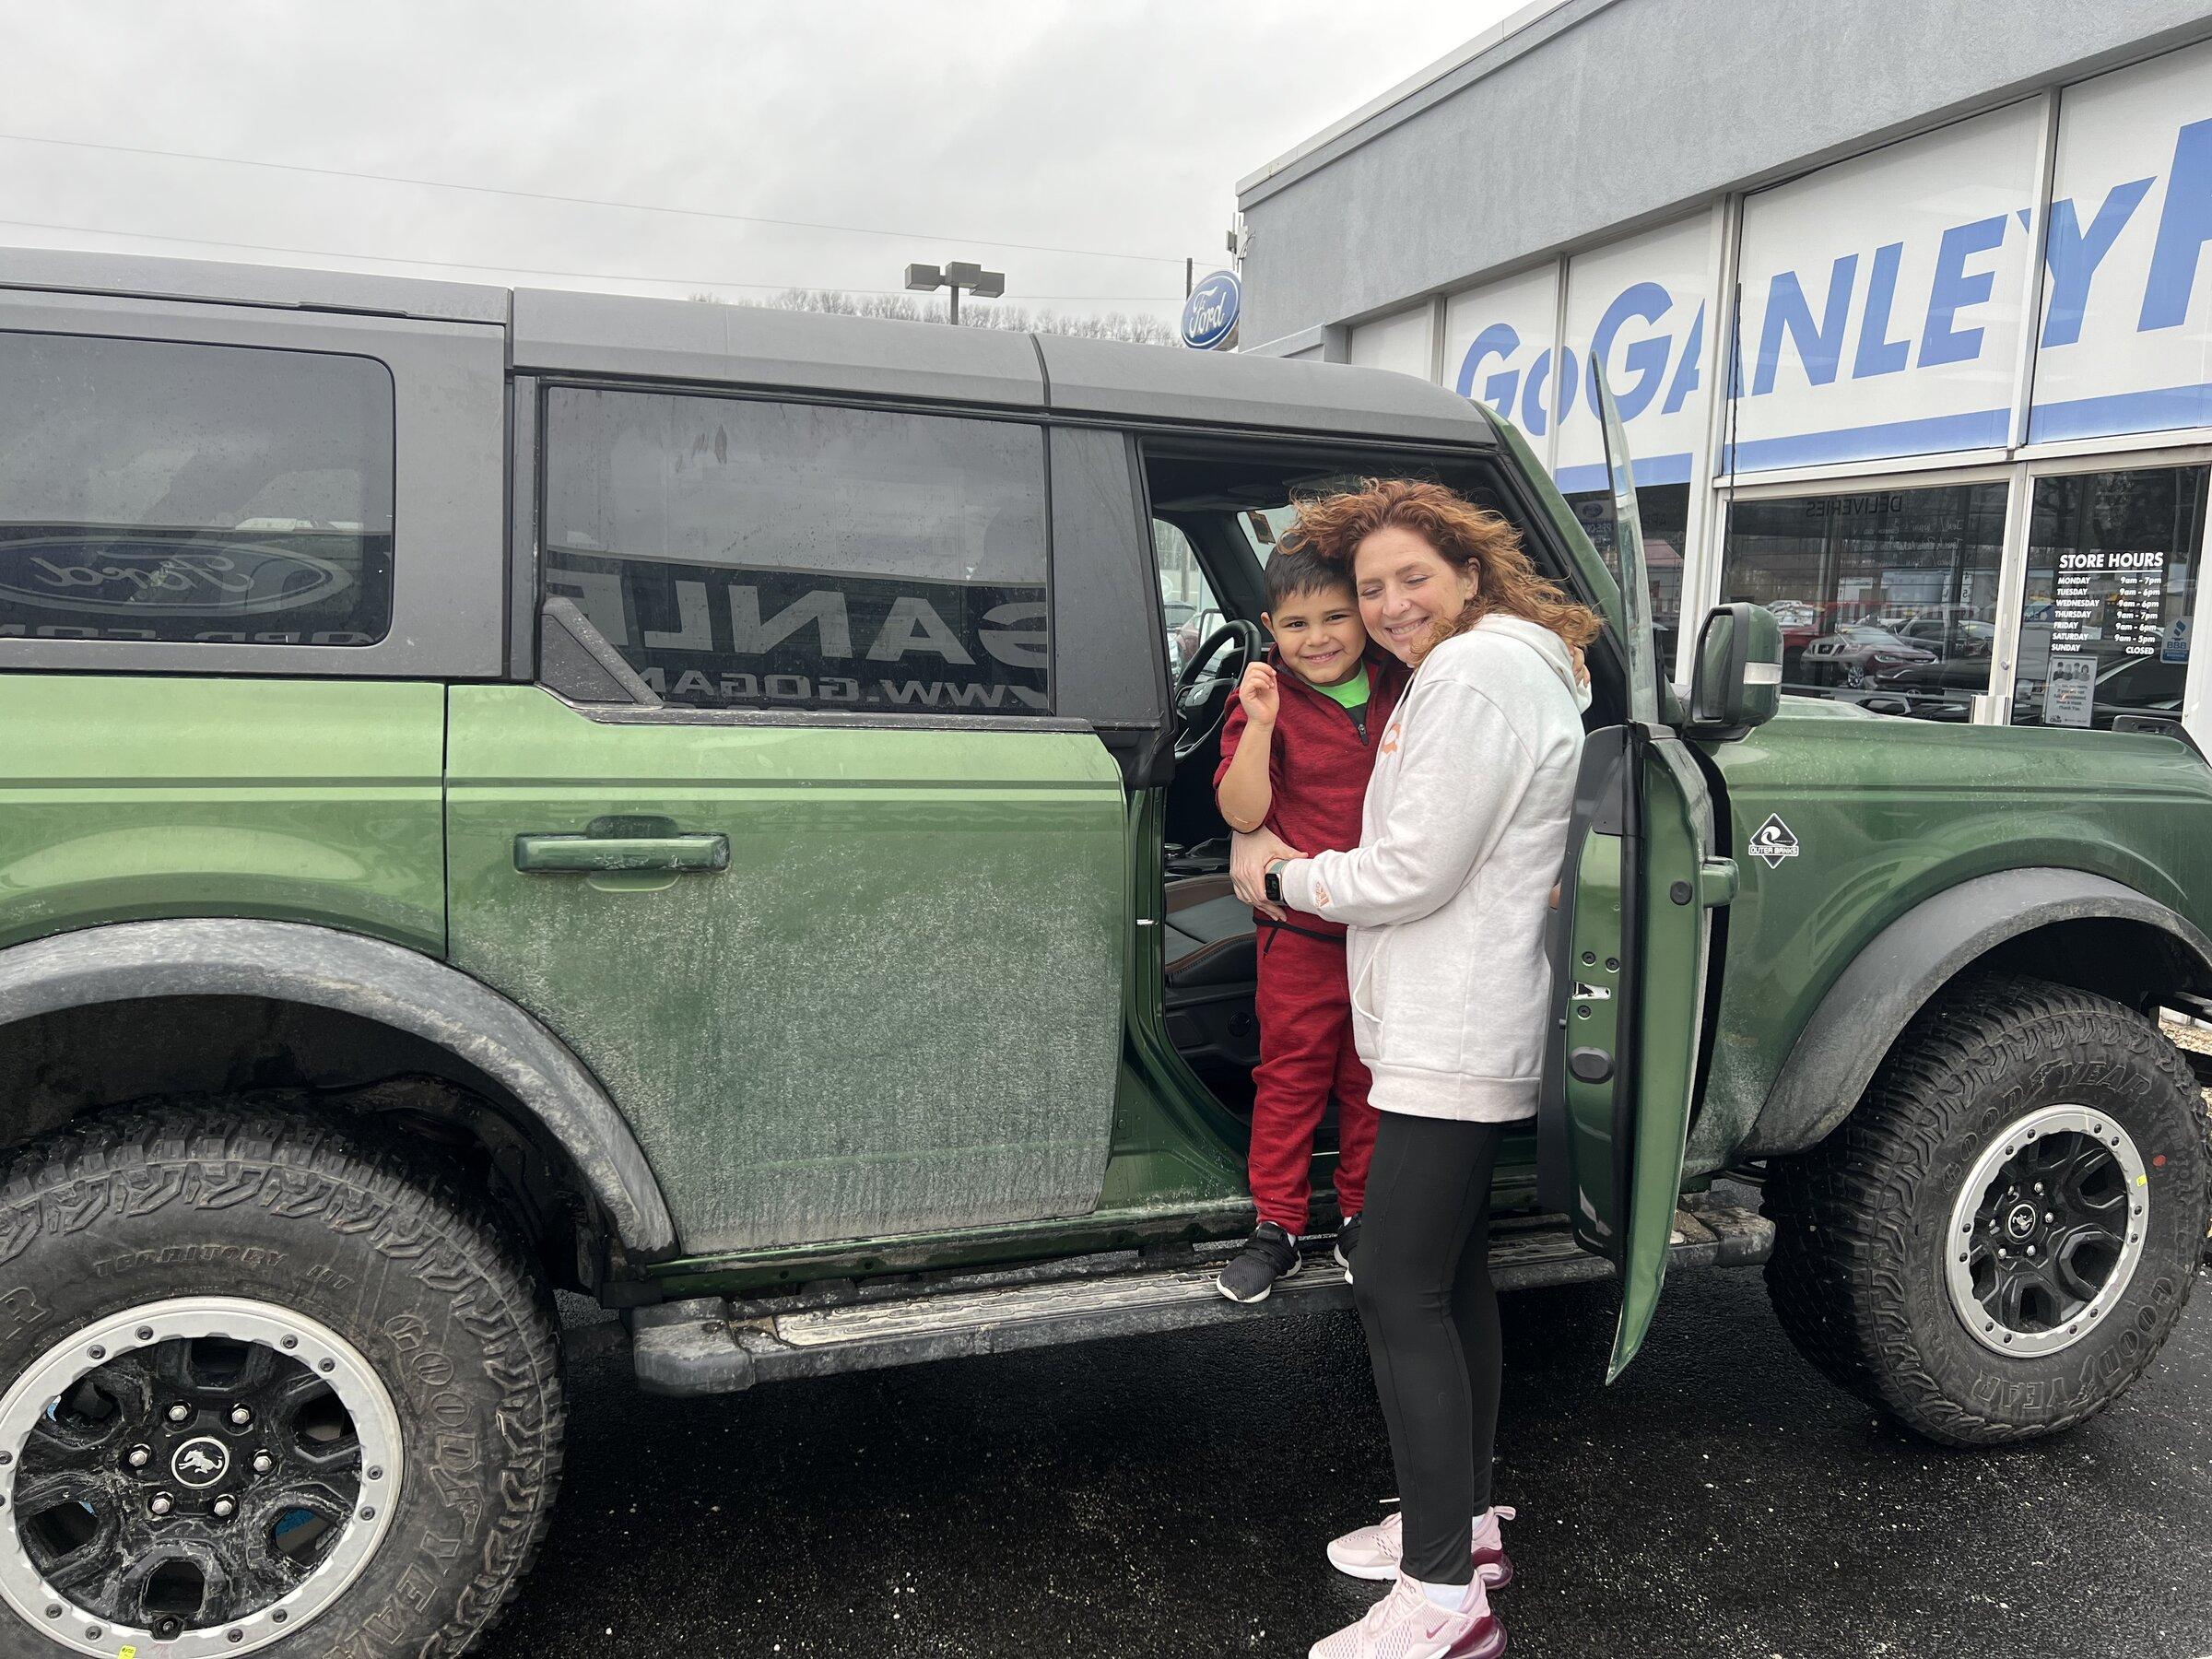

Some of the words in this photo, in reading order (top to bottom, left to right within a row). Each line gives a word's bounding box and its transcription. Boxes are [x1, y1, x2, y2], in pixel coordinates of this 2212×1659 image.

[1189, 286, 1227, 339] Ford
[2059, 553, 2104, 569] STORE
[2108, 552, 2164, 568] HOURS
[2057, 576, 2091, 585] MONDAY
[2120, 576, 2137, 584] 9am
[2144, 576, 2162, 585] 7pm
[2056, 588, 2088, 596] TUESDAY
[2119, 587, 2136, 596] 9am
[2143, 588, 2160, 597] 6pm
[2055, 599, 2100, 607] WEDNESDAY
[2118, 599, 2136, 607] 9am
[2141, 600, 2159, 609] 6pm
[2054, 610, 2092, 618] THURSDAY
[2116, 610, 2134, 619] 9am
[2140, 611, 2159, 621] 7pm
[2053, 621, 2079, 629] FRIDAY
[2115, 622, 2133, 630] 9am
[2138, 623, 2157, 632] 6pm
[2052, 632, 2088, 641] SATURDAY
[2113, 633, 2131, 642] 9am
[2137, 635, 2156, 644] 5pm
[2051, 643, 2081, 652] SUNDAY
[2125, 646, 2155, 655] CLOSED
[1751, 846, 1772, 854] OUTER
[1774, 846, 1797, 854] BANKS
[92, 1242, 288, 1278] TERRITORY
